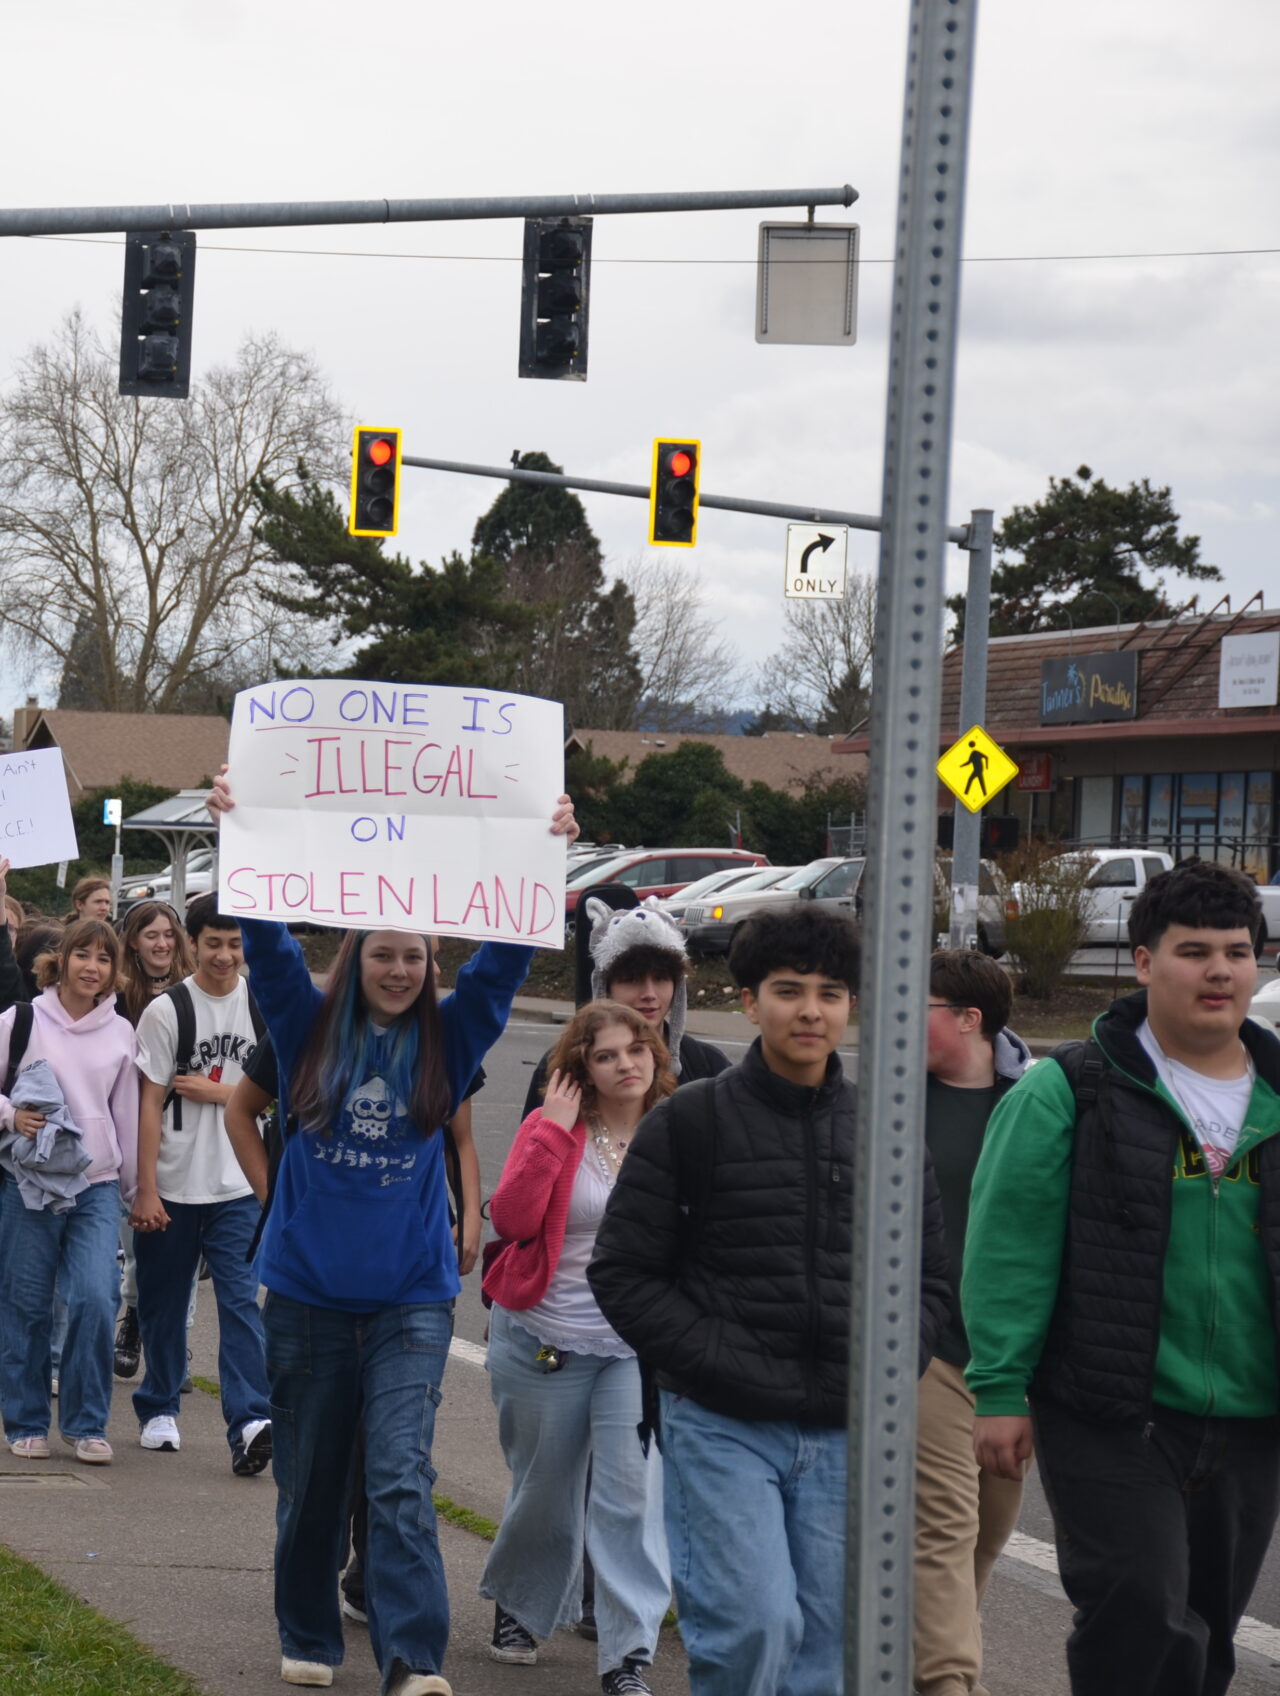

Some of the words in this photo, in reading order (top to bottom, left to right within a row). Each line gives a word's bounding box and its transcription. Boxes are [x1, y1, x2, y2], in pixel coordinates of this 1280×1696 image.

[794, 578, 837, 593] ONLY
[250, 686, 315, 724] NO
[339, 690, 429, 726] ONE
[461, 696, 517, 735] IS
[305, 736, 498, 799] ILLEGAL
[351, 815, 406, 842] ON
[227, 867, 414, 916] STOLEN
[433, 873, 556, 936] LAND
